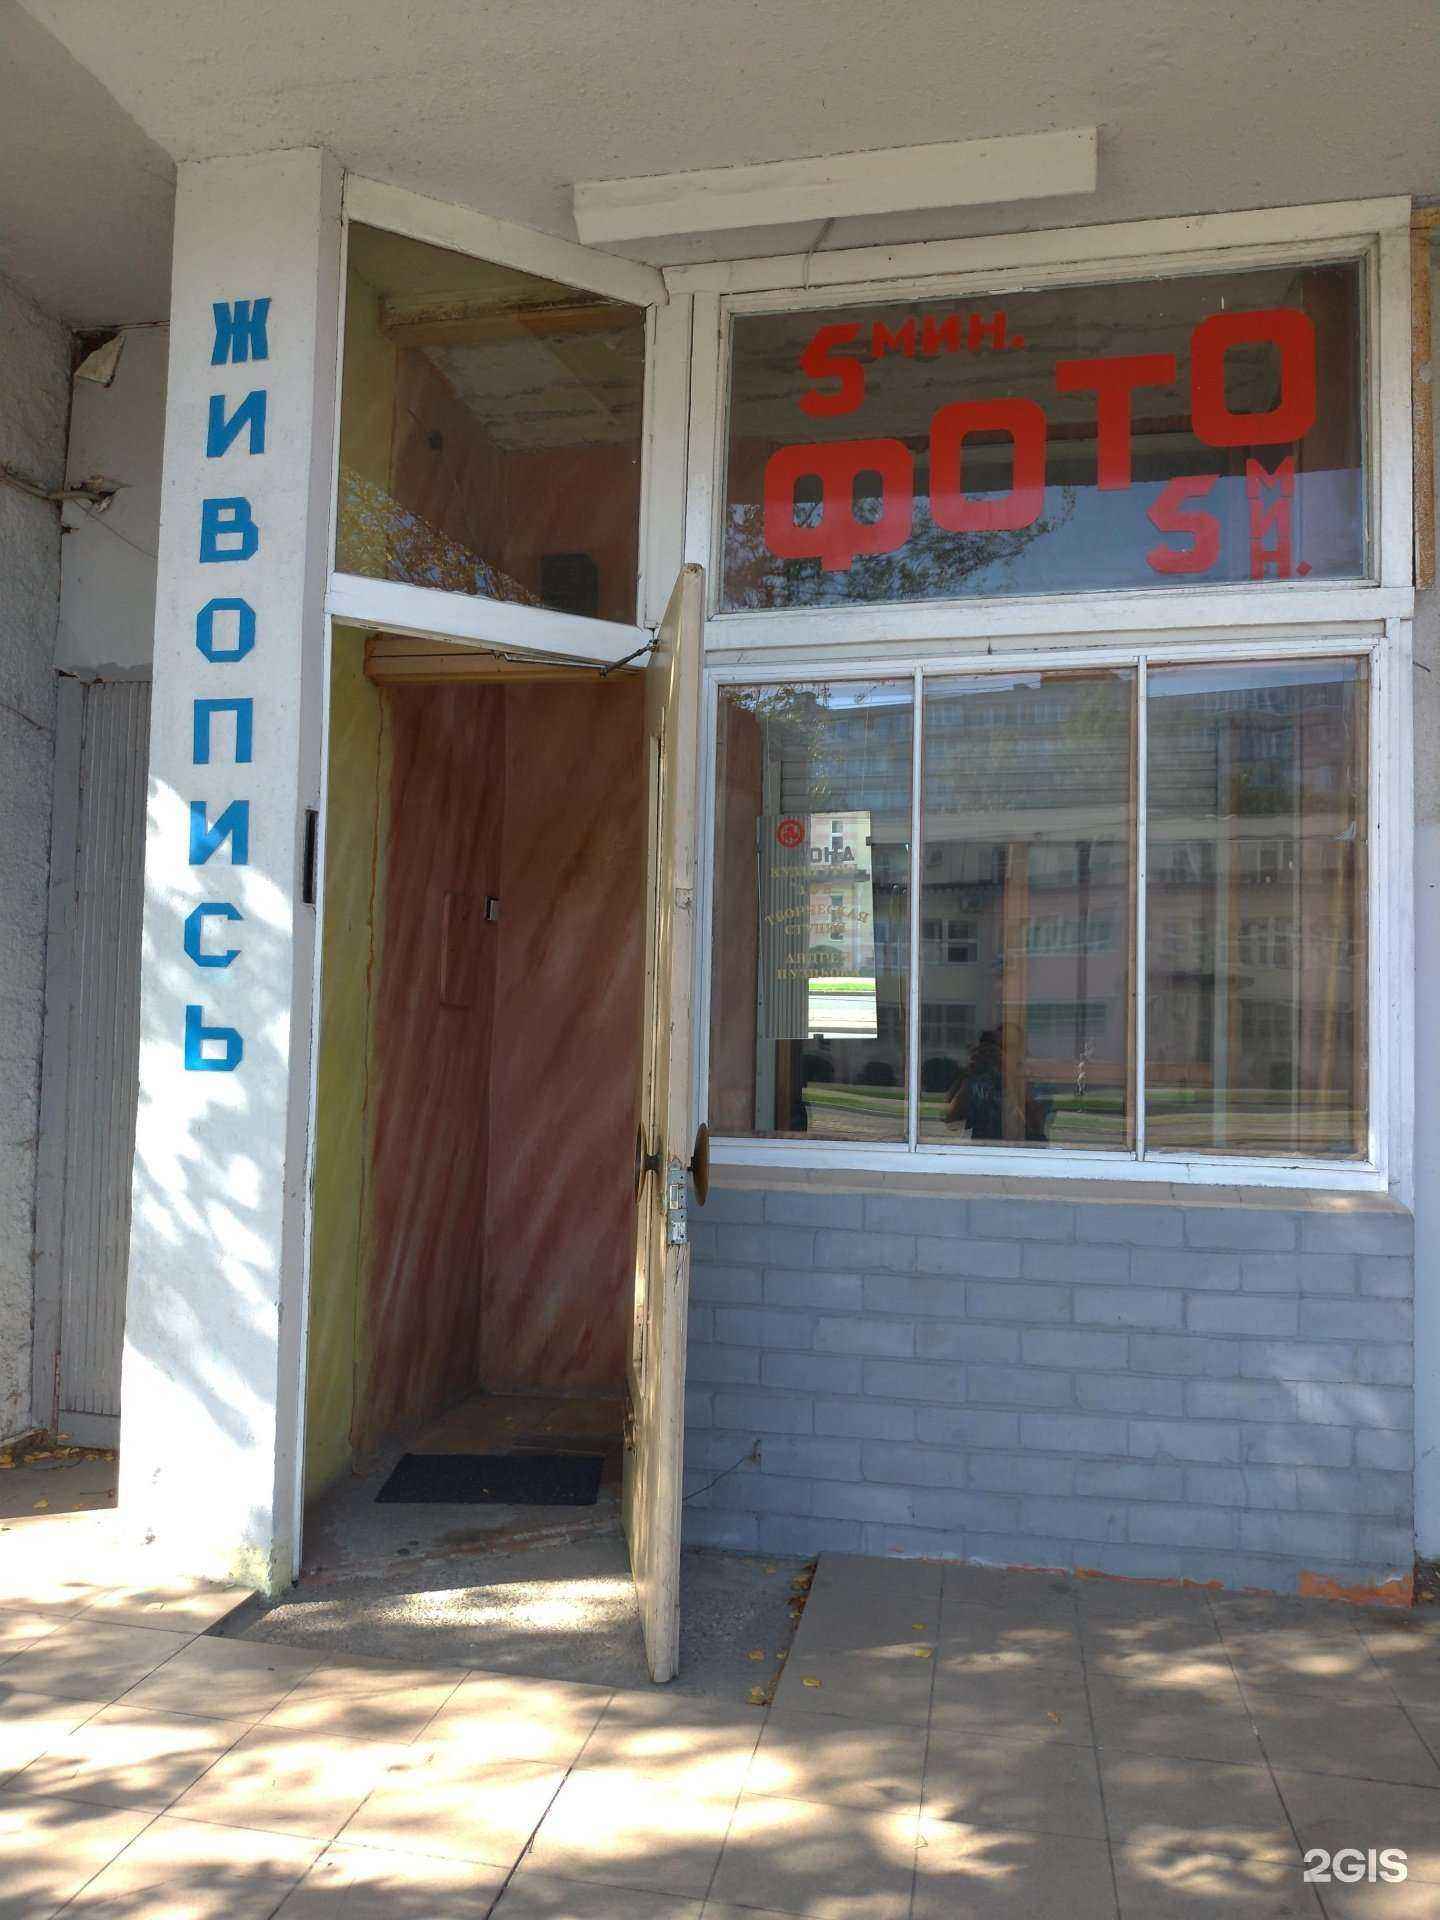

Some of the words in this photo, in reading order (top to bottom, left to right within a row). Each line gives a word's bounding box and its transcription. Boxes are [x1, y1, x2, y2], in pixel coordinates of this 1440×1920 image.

[763, 306, 1319, 572] ФОТО
[796, 321, 866, 419] 5
[1146, 474, 1221, 574] 5
[184, 298, 269, 1073] ЖИВОПИСЬ
